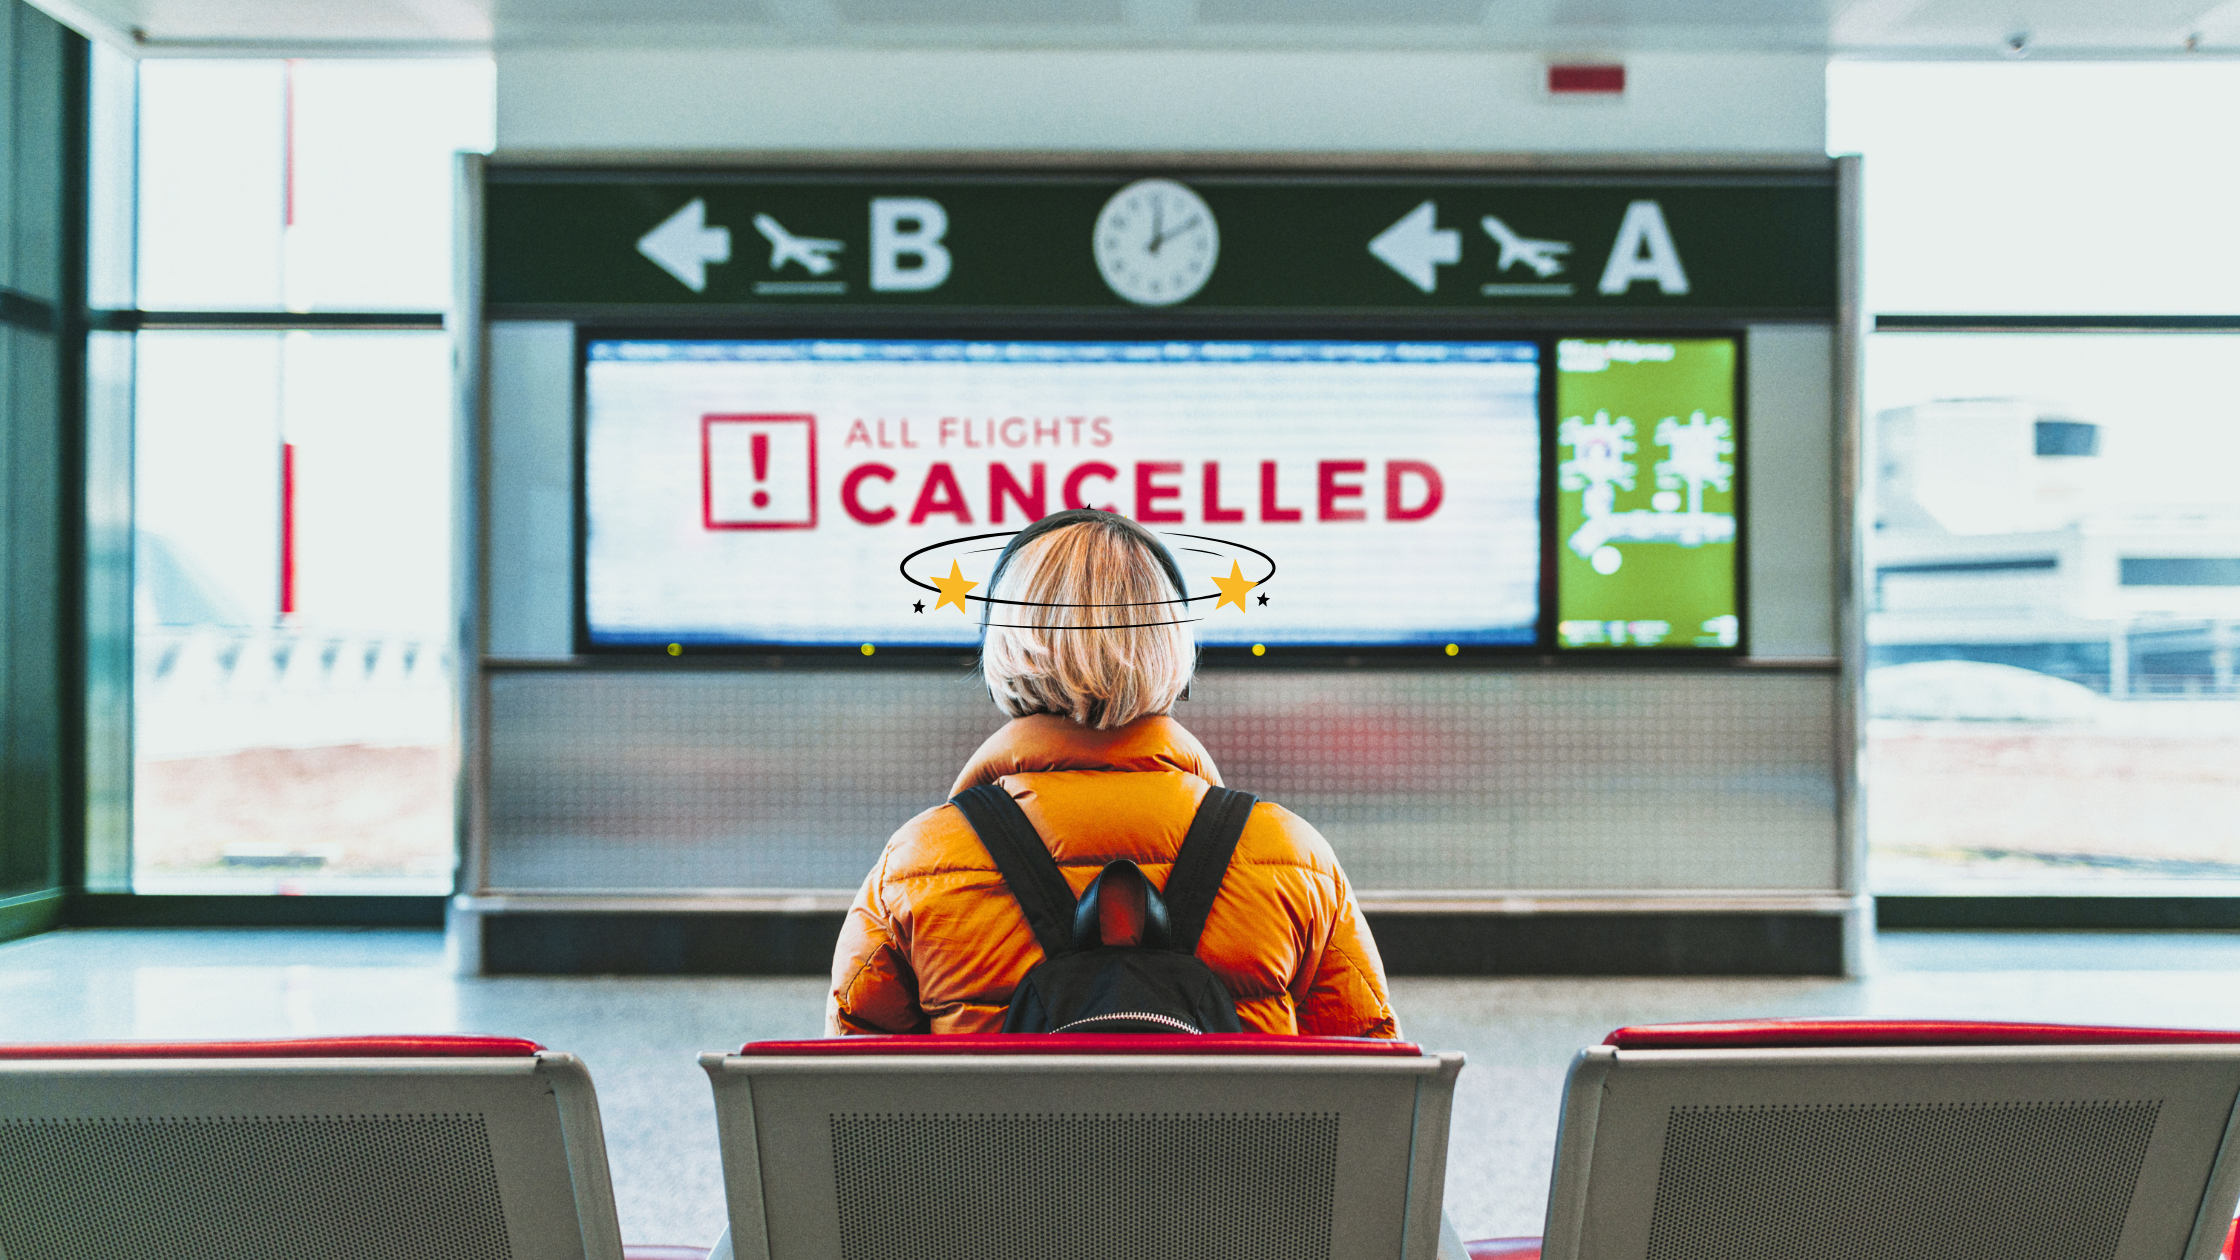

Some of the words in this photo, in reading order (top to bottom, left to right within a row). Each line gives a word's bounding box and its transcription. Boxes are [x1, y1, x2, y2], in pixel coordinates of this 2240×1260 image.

[870, 199, 951, 291] B
[1600, 201, 1690, 294] A
[846, 418, 918, 447] ALL
[938, 417, 1113, 447] FLIGHTS
[840, 460, 1445, 526] CANCELLED
